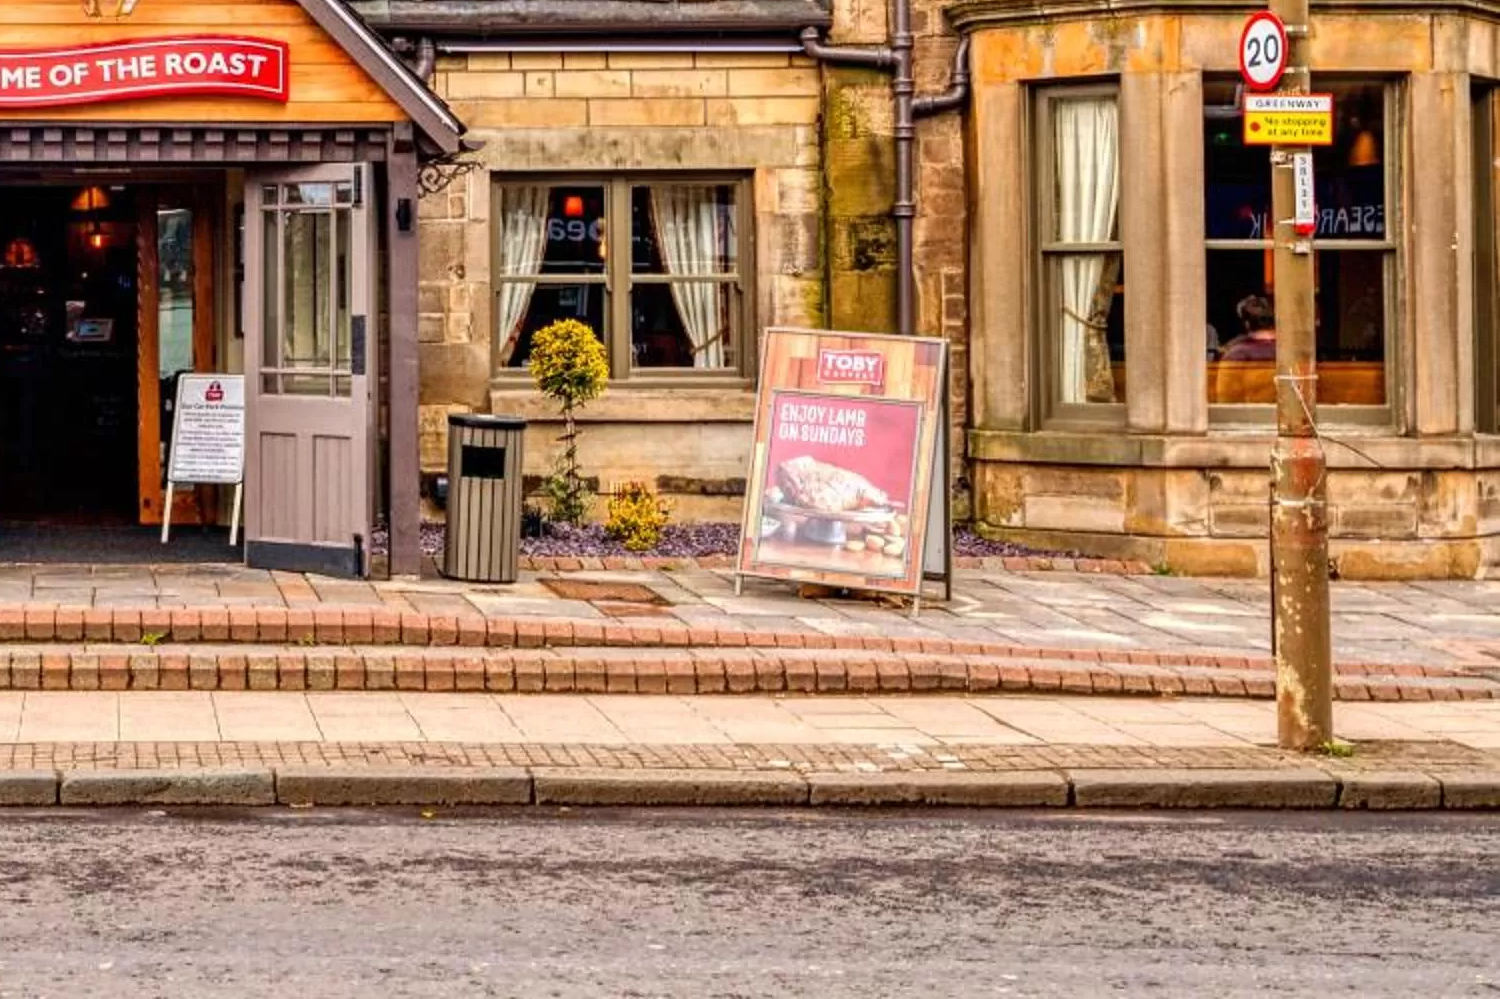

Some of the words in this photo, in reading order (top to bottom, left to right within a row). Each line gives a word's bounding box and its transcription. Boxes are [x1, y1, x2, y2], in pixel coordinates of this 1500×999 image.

[1247, 34, 1279, 68] 20
[48, 62, 90, 87] OF
[96, 56, 156, 83] THE
[165, 52, 268, 78] ROAST
[1255, 98, 1320, 109] GREENWAY
[1264, 116, 1280, 126] No
[1282, 116, 1327, 128] stopping
[1280, 129, 1299, 138] any
[1301, 128, 1324, 137] time
[824, 354, 878, 372] TOBY
[781, 402, 825, 422] ENJOY
[829, 408, 866, 427] LAMB
[779, 422, 799, 441] ON
[802, 425, 865, 446] SUNDAYS
